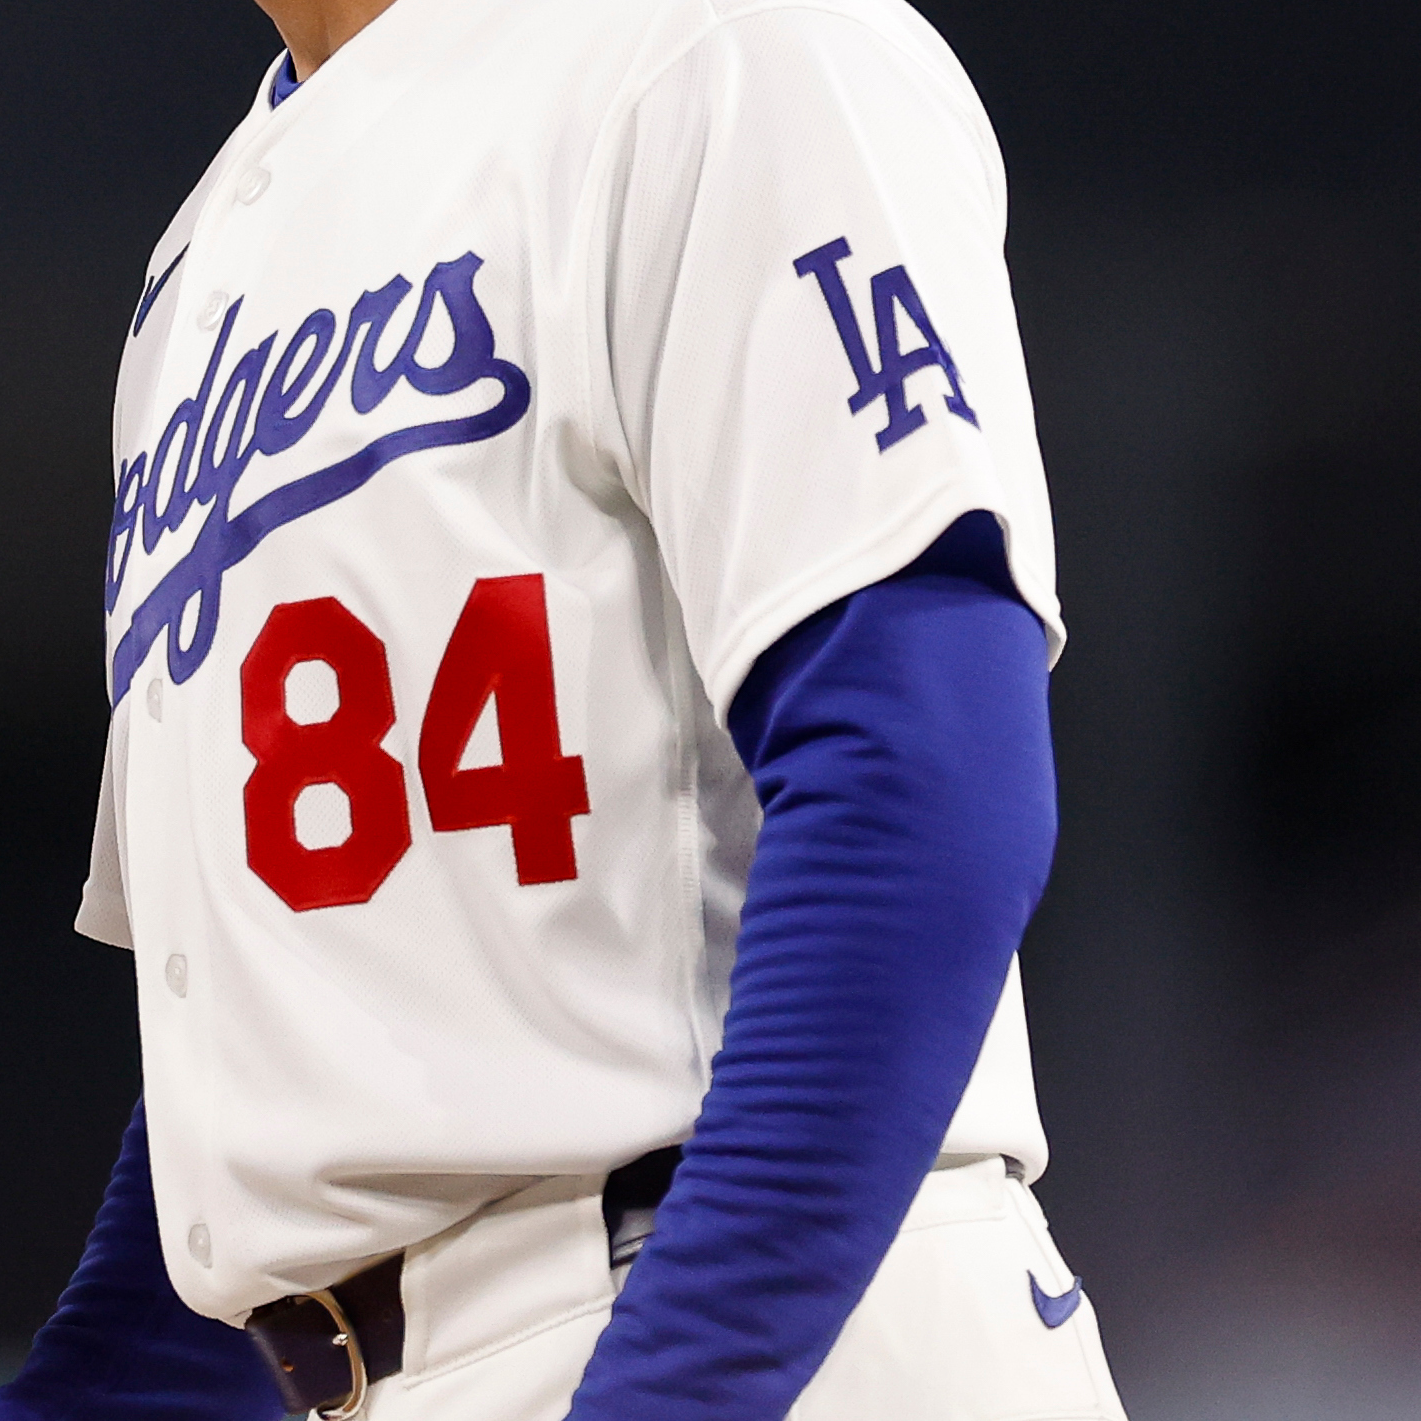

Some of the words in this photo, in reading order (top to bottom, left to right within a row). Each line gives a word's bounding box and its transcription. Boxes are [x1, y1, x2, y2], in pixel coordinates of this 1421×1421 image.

[105, 250, 531, 710] odgers
[793, 236, 981, 455] LA
[240, 572, 591, 914] 84
